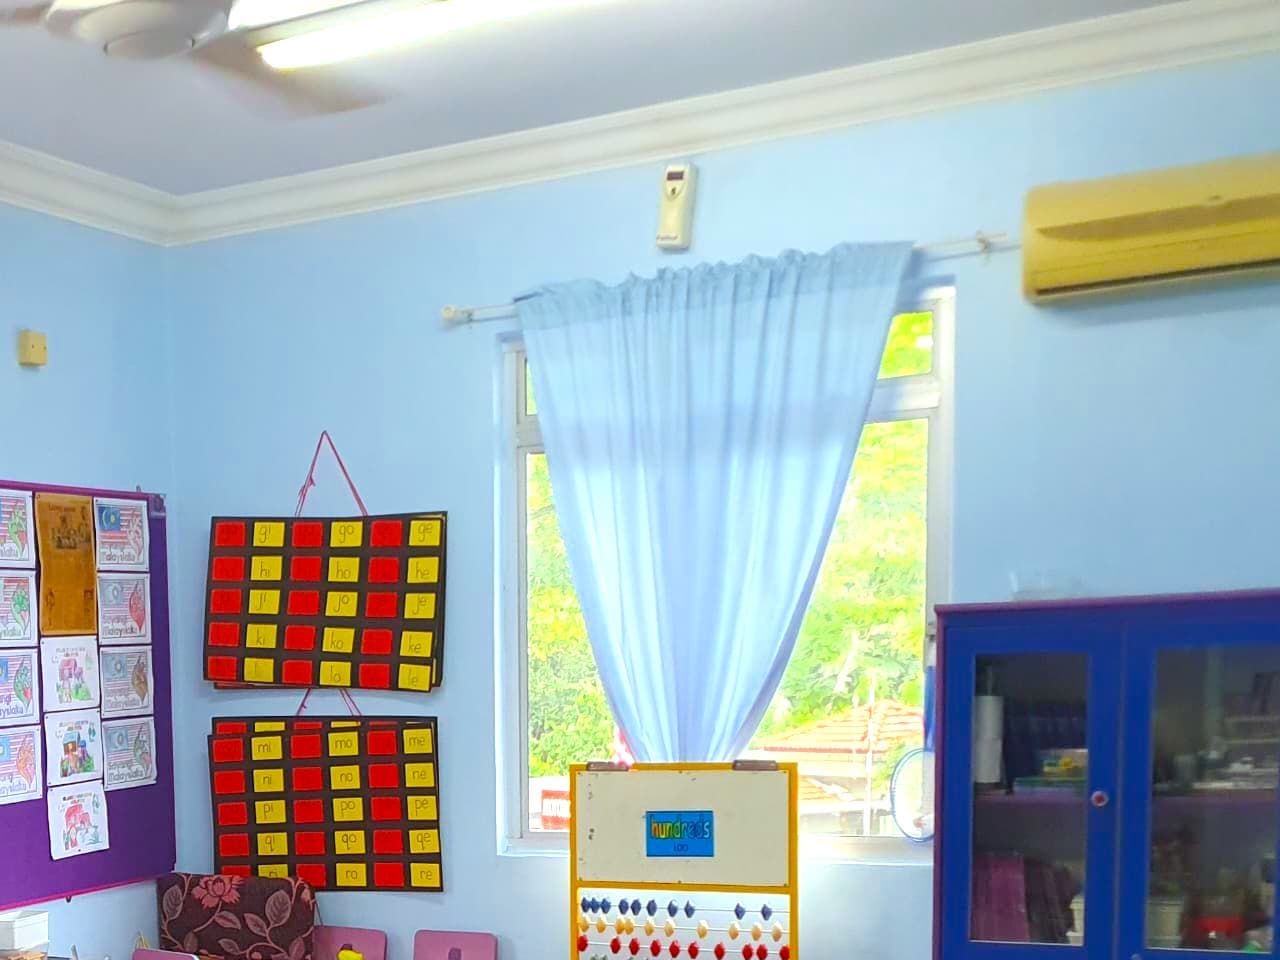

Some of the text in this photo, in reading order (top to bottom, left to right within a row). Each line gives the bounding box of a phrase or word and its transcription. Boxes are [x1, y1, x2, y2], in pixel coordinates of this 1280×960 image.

[338, 524, 355, 543] go
[418, 523, 433, 542] ge
[336, 562, 352, 580] ho
[415, 563, 430, 580] he
[333, 594, 350, 613] jo
[330, 631, 344, 650] ko
[408, 635, 423, 653] ke
[330, 664, 342, 683] lo
[257, 734, 426, 754] mi mo me
[262, 768, 427, 785] ni no ne
[263, 797, 429, 819] pi po pe
[650, 814, 711, 840] hundreds
[264, 832, 431, 852] qi qo qe
[345, 868, 358, 881] ro
[419, 868, 432, 881] re
